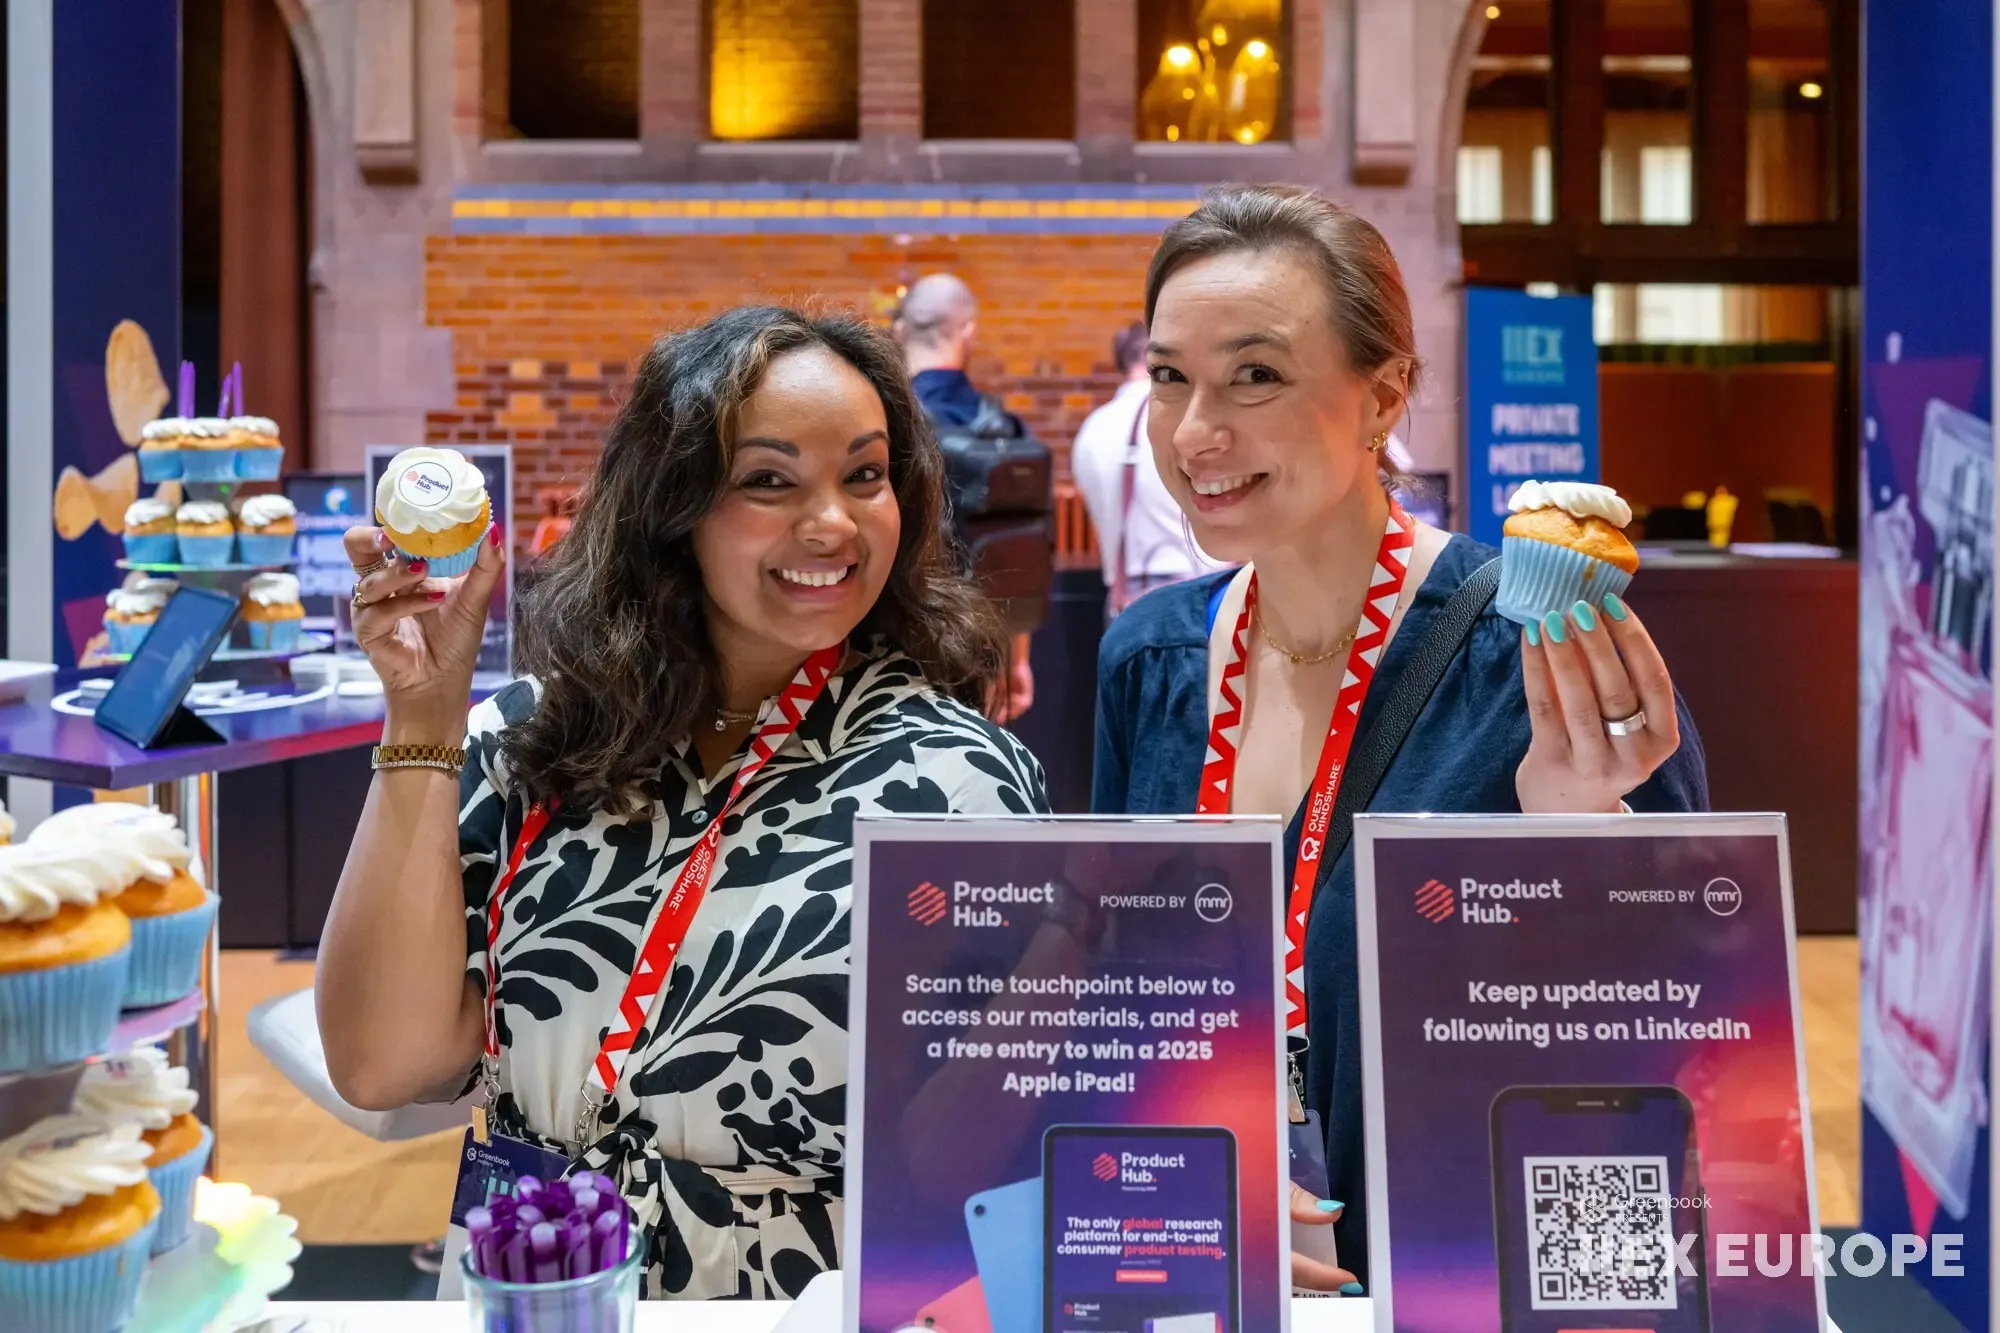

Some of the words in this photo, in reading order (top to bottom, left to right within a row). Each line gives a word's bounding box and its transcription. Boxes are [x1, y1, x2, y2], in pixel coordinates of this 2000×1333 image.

[1491, 403, 1580, 435] PRIVATE
[1488, 442, 1585, 475] MEETING
[420, 474, 450, 491] Product
[1316, 763, 1341, 833] MINDSHARE
[1308, 791, 1325, 832] QUEST
[669, 843, 707, 911] MINDSHARE
[697, 850, 712, 888] QUEST
[954, 881, 1054, 904] Product
[1461, 878, 1562, 900] Product
[1609, 890, 1674, 903] POWERED
[1677, 890, 1696, 903] BY
[1100, 895, 1165, 909] POWERED
[1168, 895, 1187, 909] BY
[1462, 903, 1519, 924] Hub.
[954, 906, 1009, 928] Hub.
[906, 975, 962, 994] Scan
[967, 974, 1004, 994] the
[1009, 974, 1134, 1000] touchpoint
[1139, 975, 1207, 996] below
[1211, 977, 1235, 996] to
[1468, 981, 1538, 1009] Keep
[1543, 980, 1661, 1008] updated
[1666, 979, 1702, 1008] by
[902, 1010, 982, 1027] access
[987, 1011, 1026, 1027] our
[1030, 1007, 1145, 1030] materials,
[1150, 1008, 1195, 1028] and
[1200, 1009, 1239, 1034] get
[1423, 1018, 1550, 1048] following
[1556, 1023, 1588, 1041] us
[1594, 1023, 1629, 1041] on
[1635, 1017, 1751, 1041] LinkedIn
[927, 1042, 942, 1058] a
[947, 1038, 993, 1059] free
[997, 1040, 1060, 1065] entry
[1064, 1040, 1089, 1059] to
[1093, 1039, 1135, 1060] win
[1139, 1044, 1154, 1061] a
[1158, 1040, 1213, 1061] 2025
[1003, 1071, 1071, 1098] Apple
[1075, 1072, 1135, 1093] iPad!
[478, 1150, 510, 1167] Greenbook
[1121, 1152, 1185, 1168] Product
[1121, 1168, 1157, 1184] Hub.
[1067, 1217, 1090, 1229] The
[1092, 1217, 1121, 1232] only
[1123, 1217, 1163, 1231] global
[1165, 1218, 1222, 1231] research
[1064, 1230, 1120, 1244] platform
[1122, 1230, 1141, 1243] for
[1142, 1231, 1219, 1243] end-to-end
[1057, 1245, 1122, 1255] consumer
[1124, 1244, 1175, 1258] product
[1177, 1244, 1227, 1260] testing.
